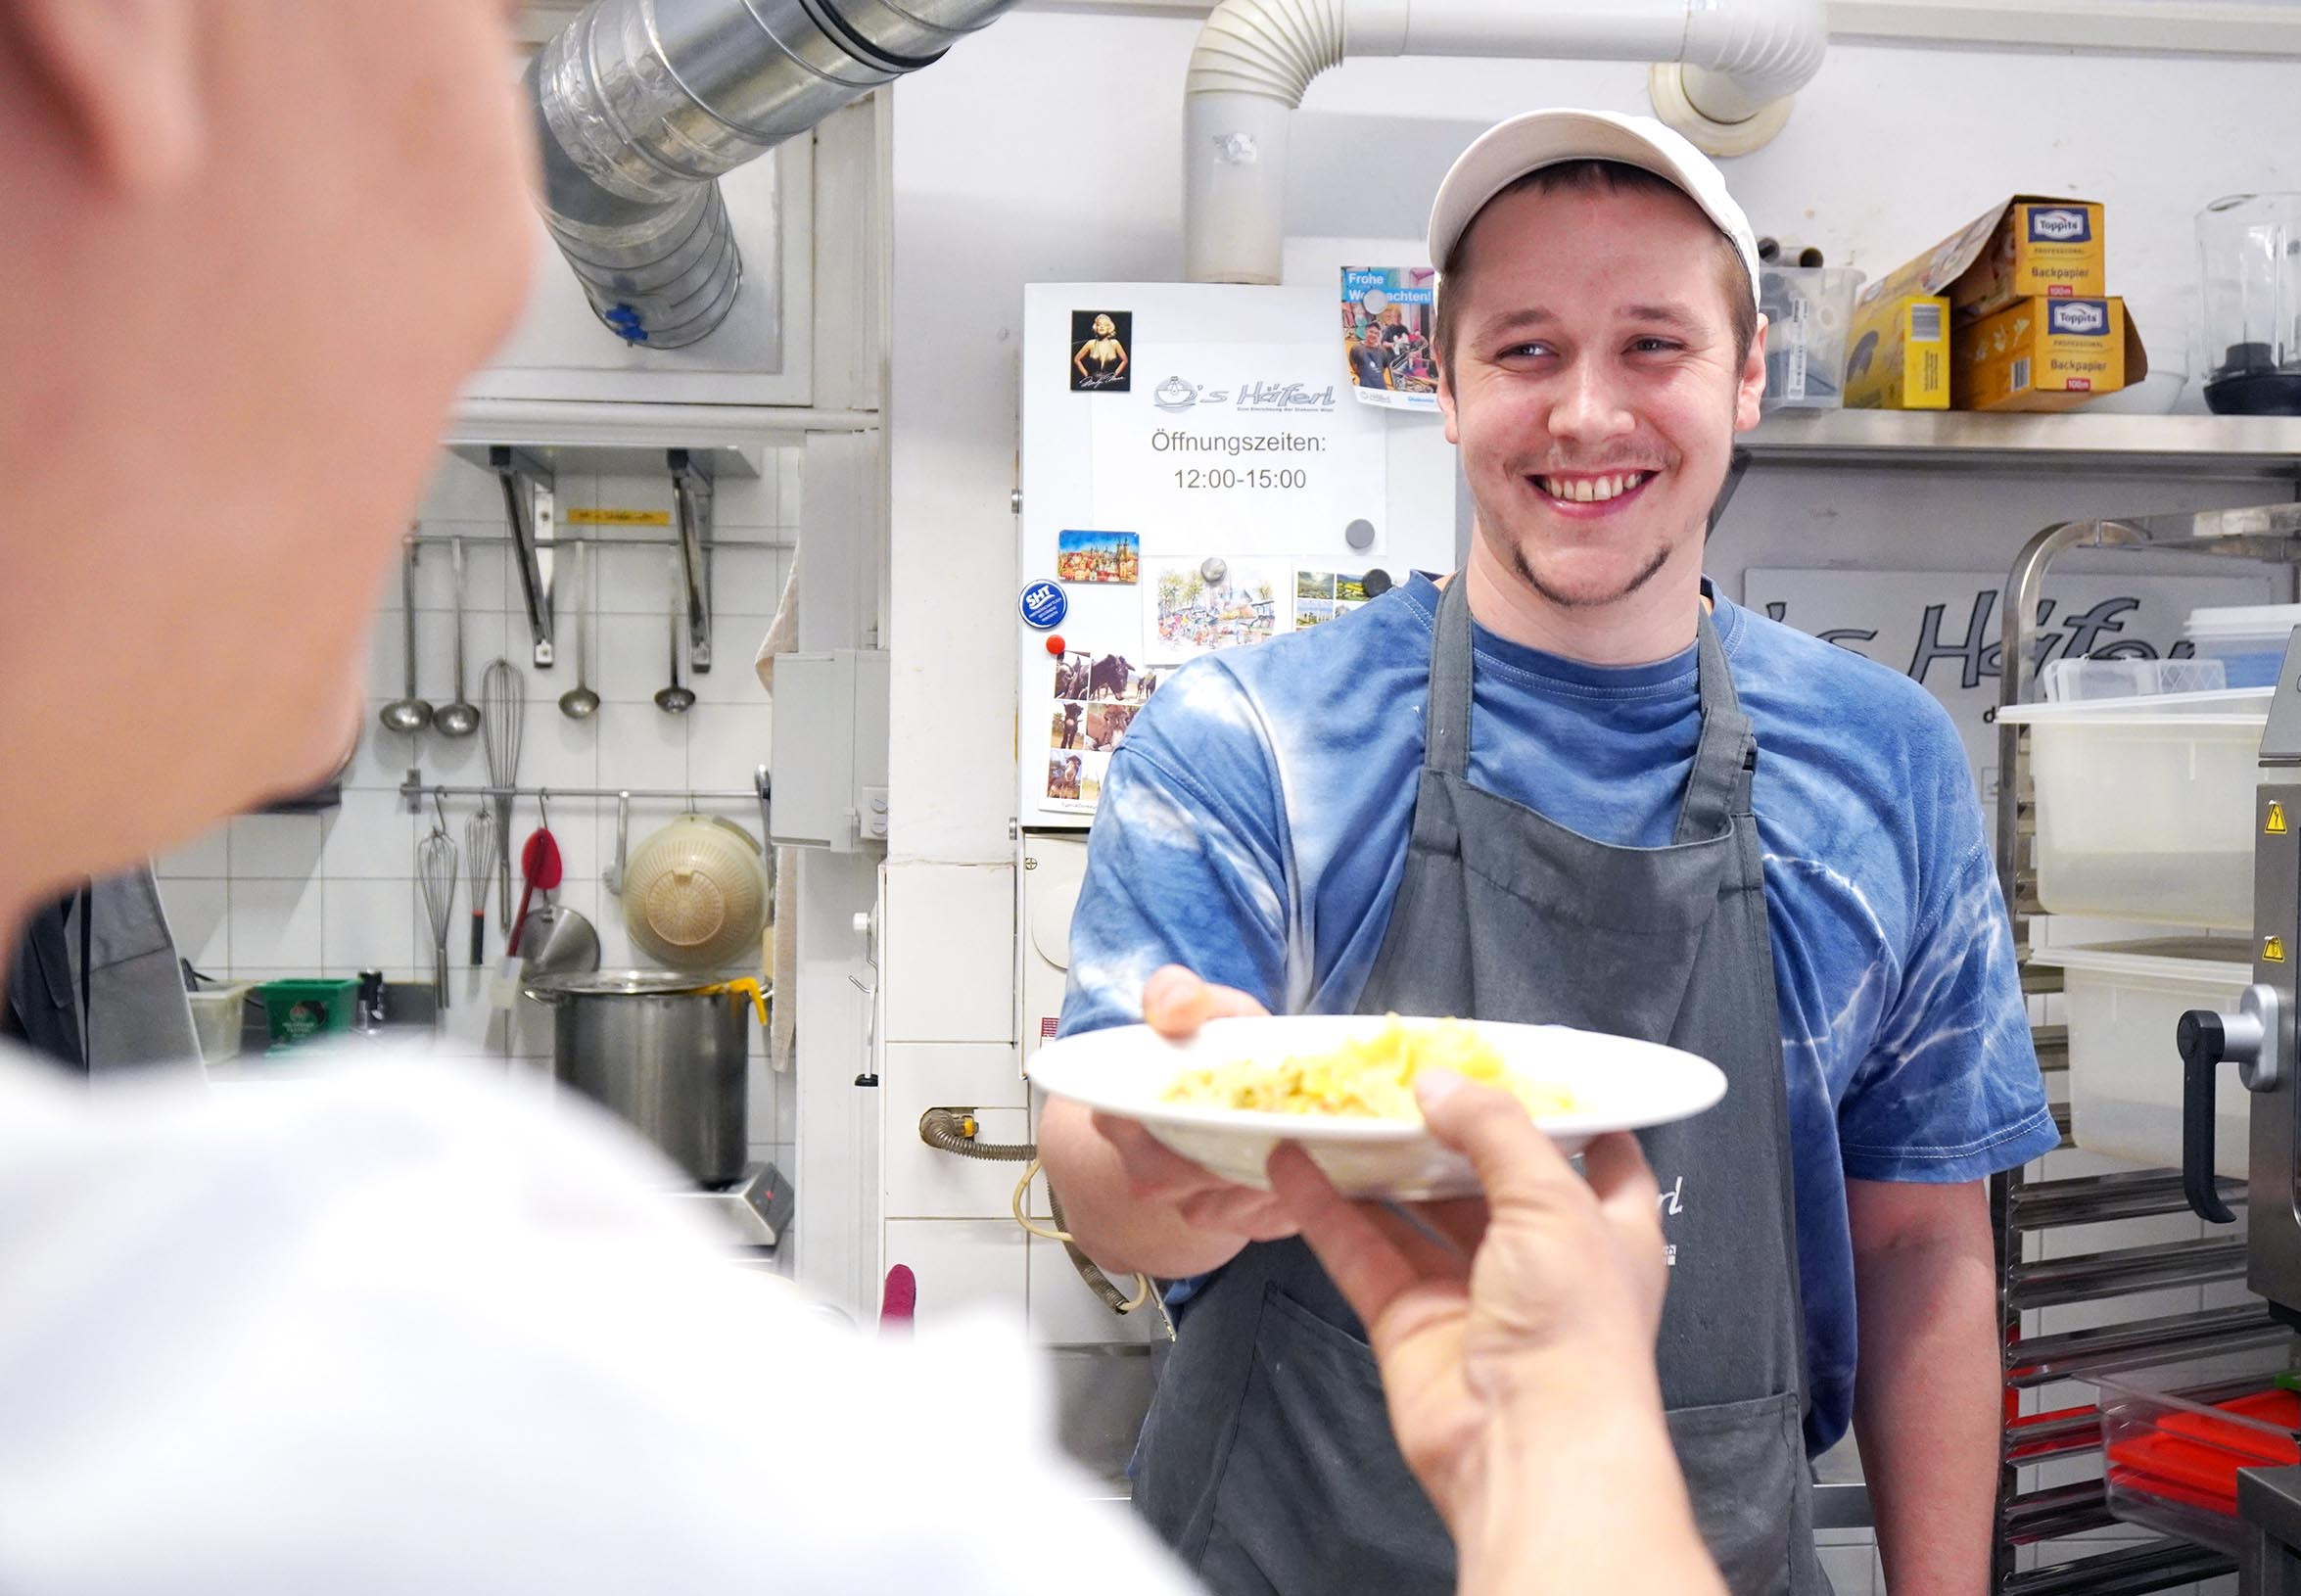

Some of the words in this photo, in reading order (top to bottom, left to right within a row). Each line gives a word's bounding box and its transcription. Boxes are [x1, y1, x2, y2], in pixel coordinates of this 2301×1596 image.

[2040, 219, 2079, 232] Toppits
[1348, 272, 1385, 285] Frohe
[2031, 266, 2090, 279] Backpapier
[1348, 289, 1432, 302] Weachten!
[2059, 311, 2097, 325] Toppits
[2050, 358, 2107, 372] Backpapier
[1236, 381, 1336, 406] Häferl
[1151, 428, 1326, 456] Öffnungszeiten:
[1174, 469, 1306, 489] 12:00-15:00
[1025, 585, 1051, 607] SHT
